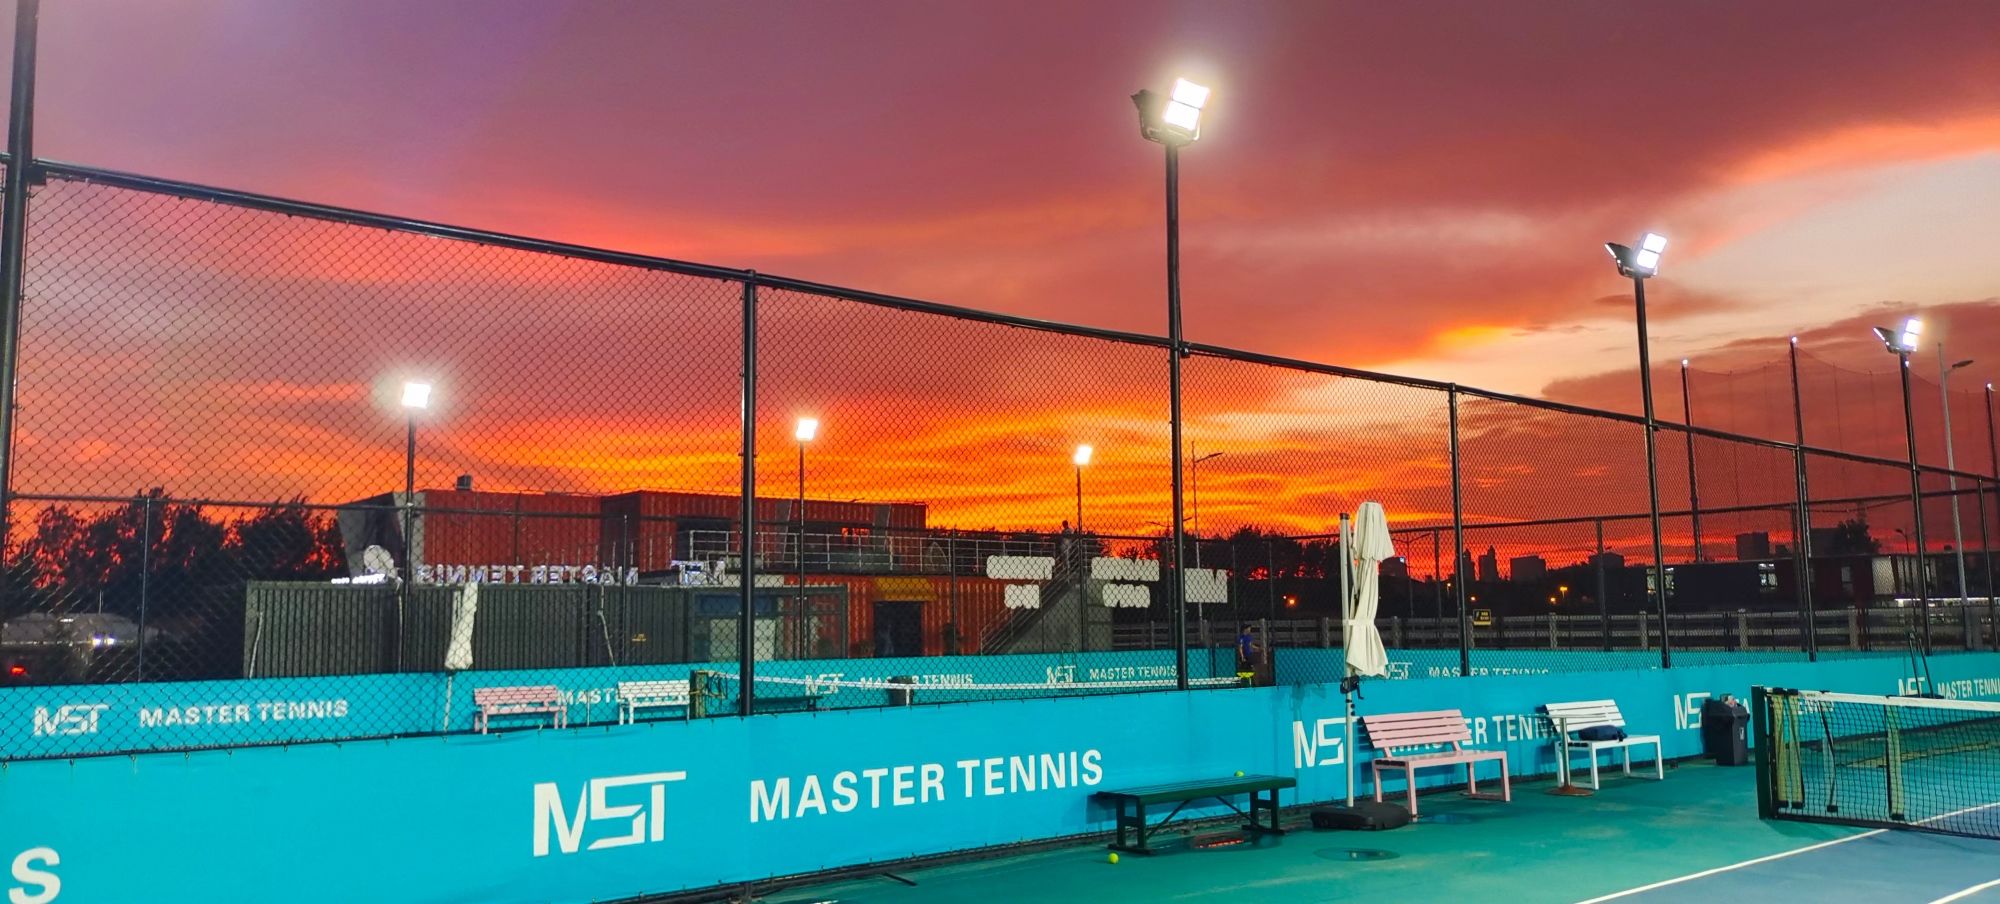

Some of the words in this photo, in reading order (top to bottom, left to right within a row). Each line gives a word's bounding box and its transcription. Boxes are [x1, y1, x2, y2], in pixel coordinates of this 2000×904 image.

[1089, 666, 1135, 680] MASTER
[1138, 664, 1178, 677] TENNIS
[1428, 667, 1489, 677] MASER
[33, 704, 109, 735] MST
[140, 704, 250, 728] MASTER
[256, 699, 349, 720] TENNIS
[1674, 692, 1711, 730] MS
[532, 771, 686, 858] MST
[749, 763, 944, 823] MASTER
[956, 749, 1104, 798] TENNIS
